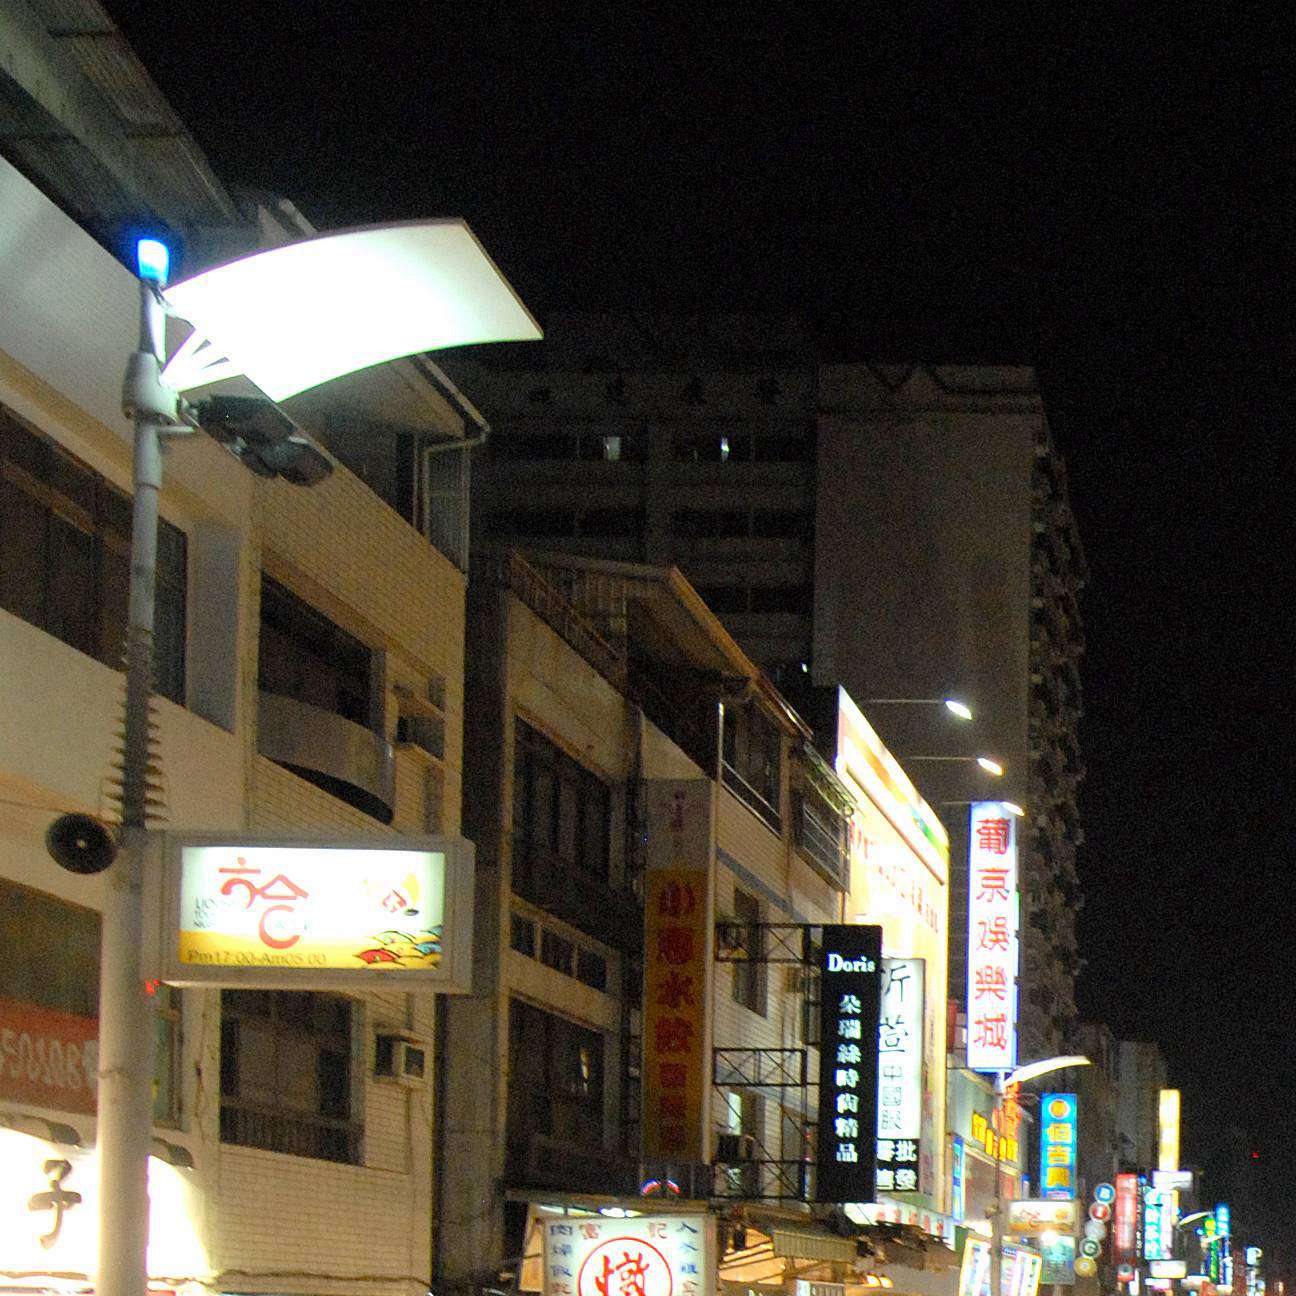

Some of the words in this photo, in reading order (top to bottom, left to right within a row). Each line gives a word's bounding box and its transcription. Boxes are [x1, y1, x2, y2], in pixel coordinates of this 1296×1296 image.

[828, 954, 876, 973] Doris
[974, 818, 1010, 1051] 葡京娛樂城
